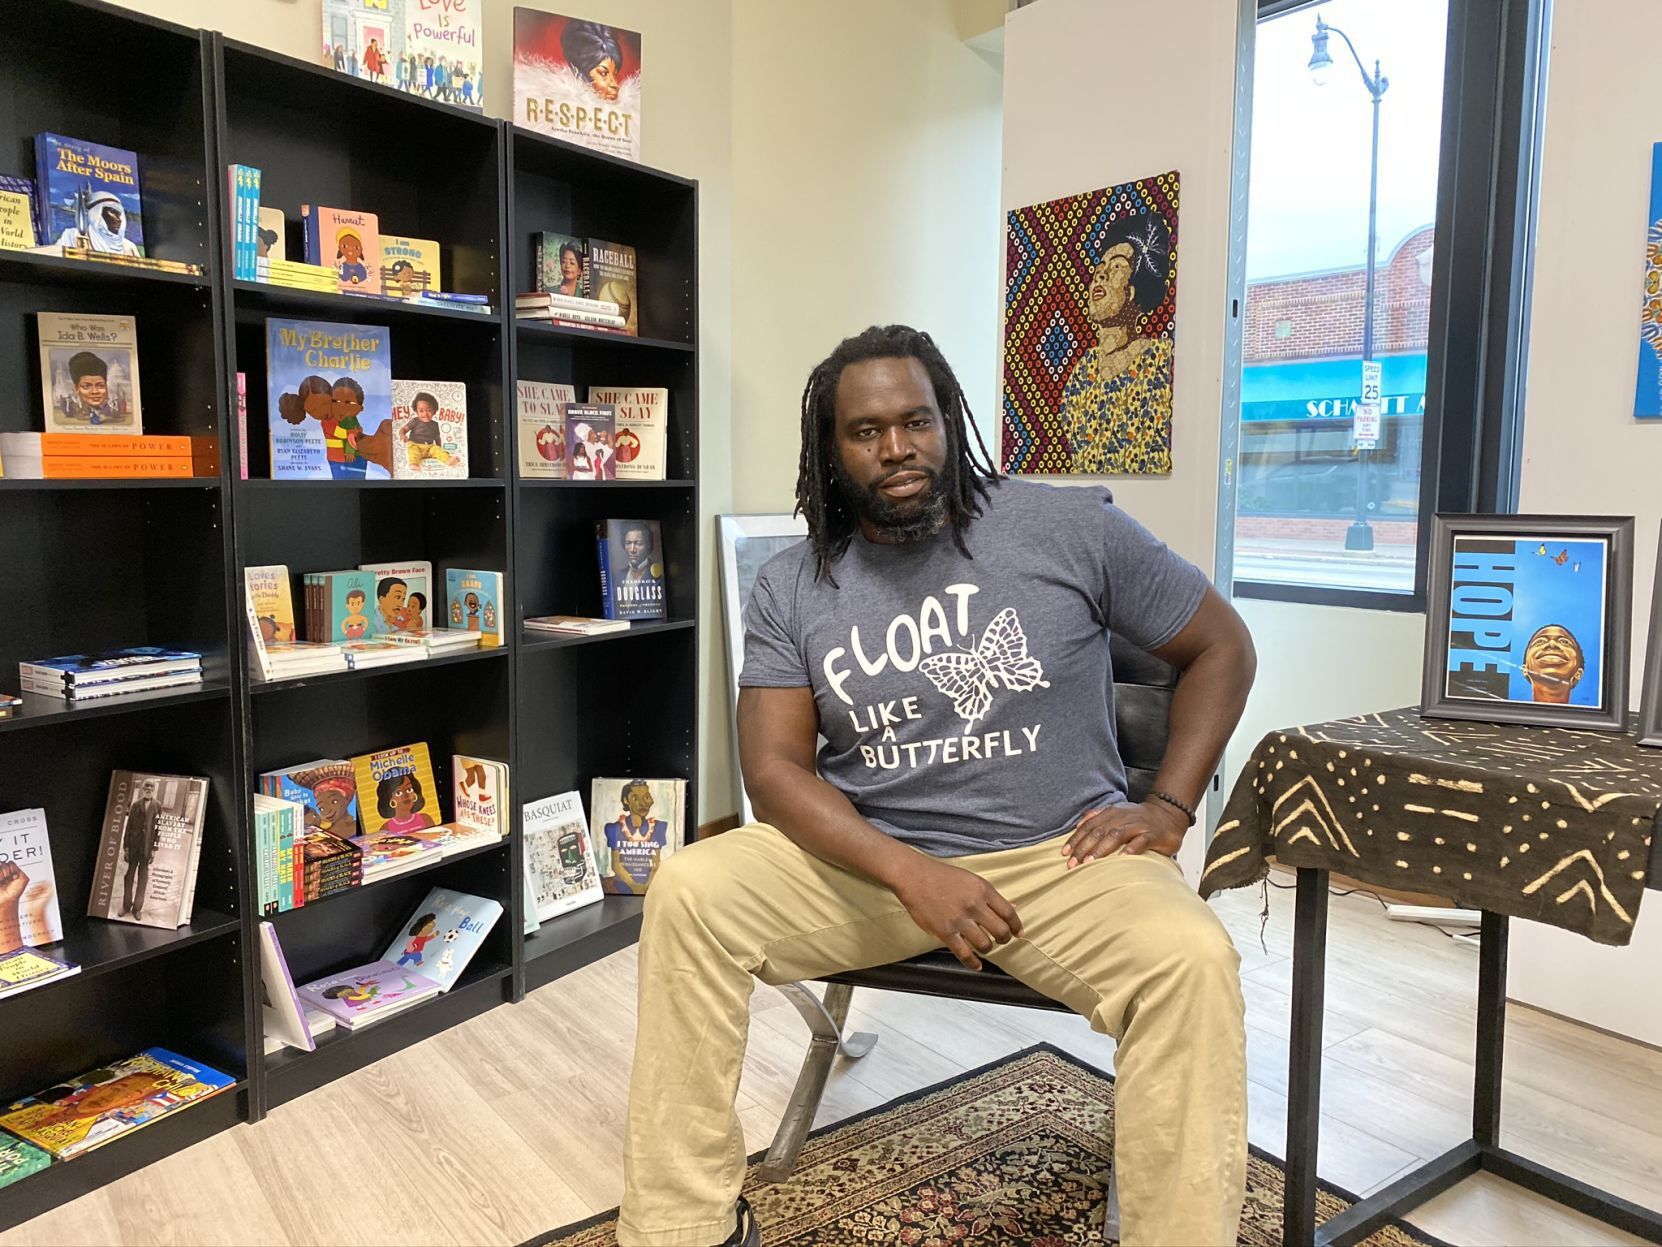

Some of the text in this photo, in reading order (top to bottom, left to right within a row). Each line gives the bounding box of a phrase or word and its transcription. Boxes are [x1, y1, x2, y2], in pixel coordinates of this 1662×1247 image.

[413, 23, 475, 47] Powerful
[57, 147, 132, 174] The Moors
[56, 160, 134, 186] After Spain
[332, 213, 366, 227] Harriet
[593, 248, 634, 269] RACEBALL
[70, 323, 87, 331] Who
[57, 330, 75, 340] Ida
[87, 332, 118, 341] Wells?
[279, 328, 380, 352] My Brother
[305, 350, 372, 372] Charlie
[517, 386, 571, 402] SHE CAME
[596, 392, 658, 405] SHE CAME
[1364, 384, 1379, 400] 25
[522, 401, 536, 414] TO
[620, 407, 652, 419] SLAY
[1306, 395, 1410, 417] SCHTT
[373, 569, 391, 577] retty
[249, 580, 279, 592] tories
[617, 586, 662, 601] DOUGLASS
[1448, 552, 1515, 674] HOPE
[823, 583, 980, 706] FLOAT
[849, 696, 922, 733] LIKE
[881, 726, 897, 742] A
[860, 724, 1041, 769] BUTTERFLY
[370, 753, 415, 771] Michelle
[372, 764, 416, 782] Obama
[456, 796, 496, 817] WHOSE KNEES
[523, 799, 573, 822] BASQUIAT
[7, 816, 38, 826] CROSS
[155, 814, 190, 823] AMERICAN
[157, 819, 186, 828] SLAVERY
[459, 809, 495, 827] ARE THESE?
[14, 833, 30, 845] IT
[98, 782, 127, 907] RIVER OF BLOOD
[622, 840, 639, 848] TOO
[619, 848, 656, 856] AMERICA
[458, 916, 484, 934] Ball
[306, 980, 339, 993] Rosa
